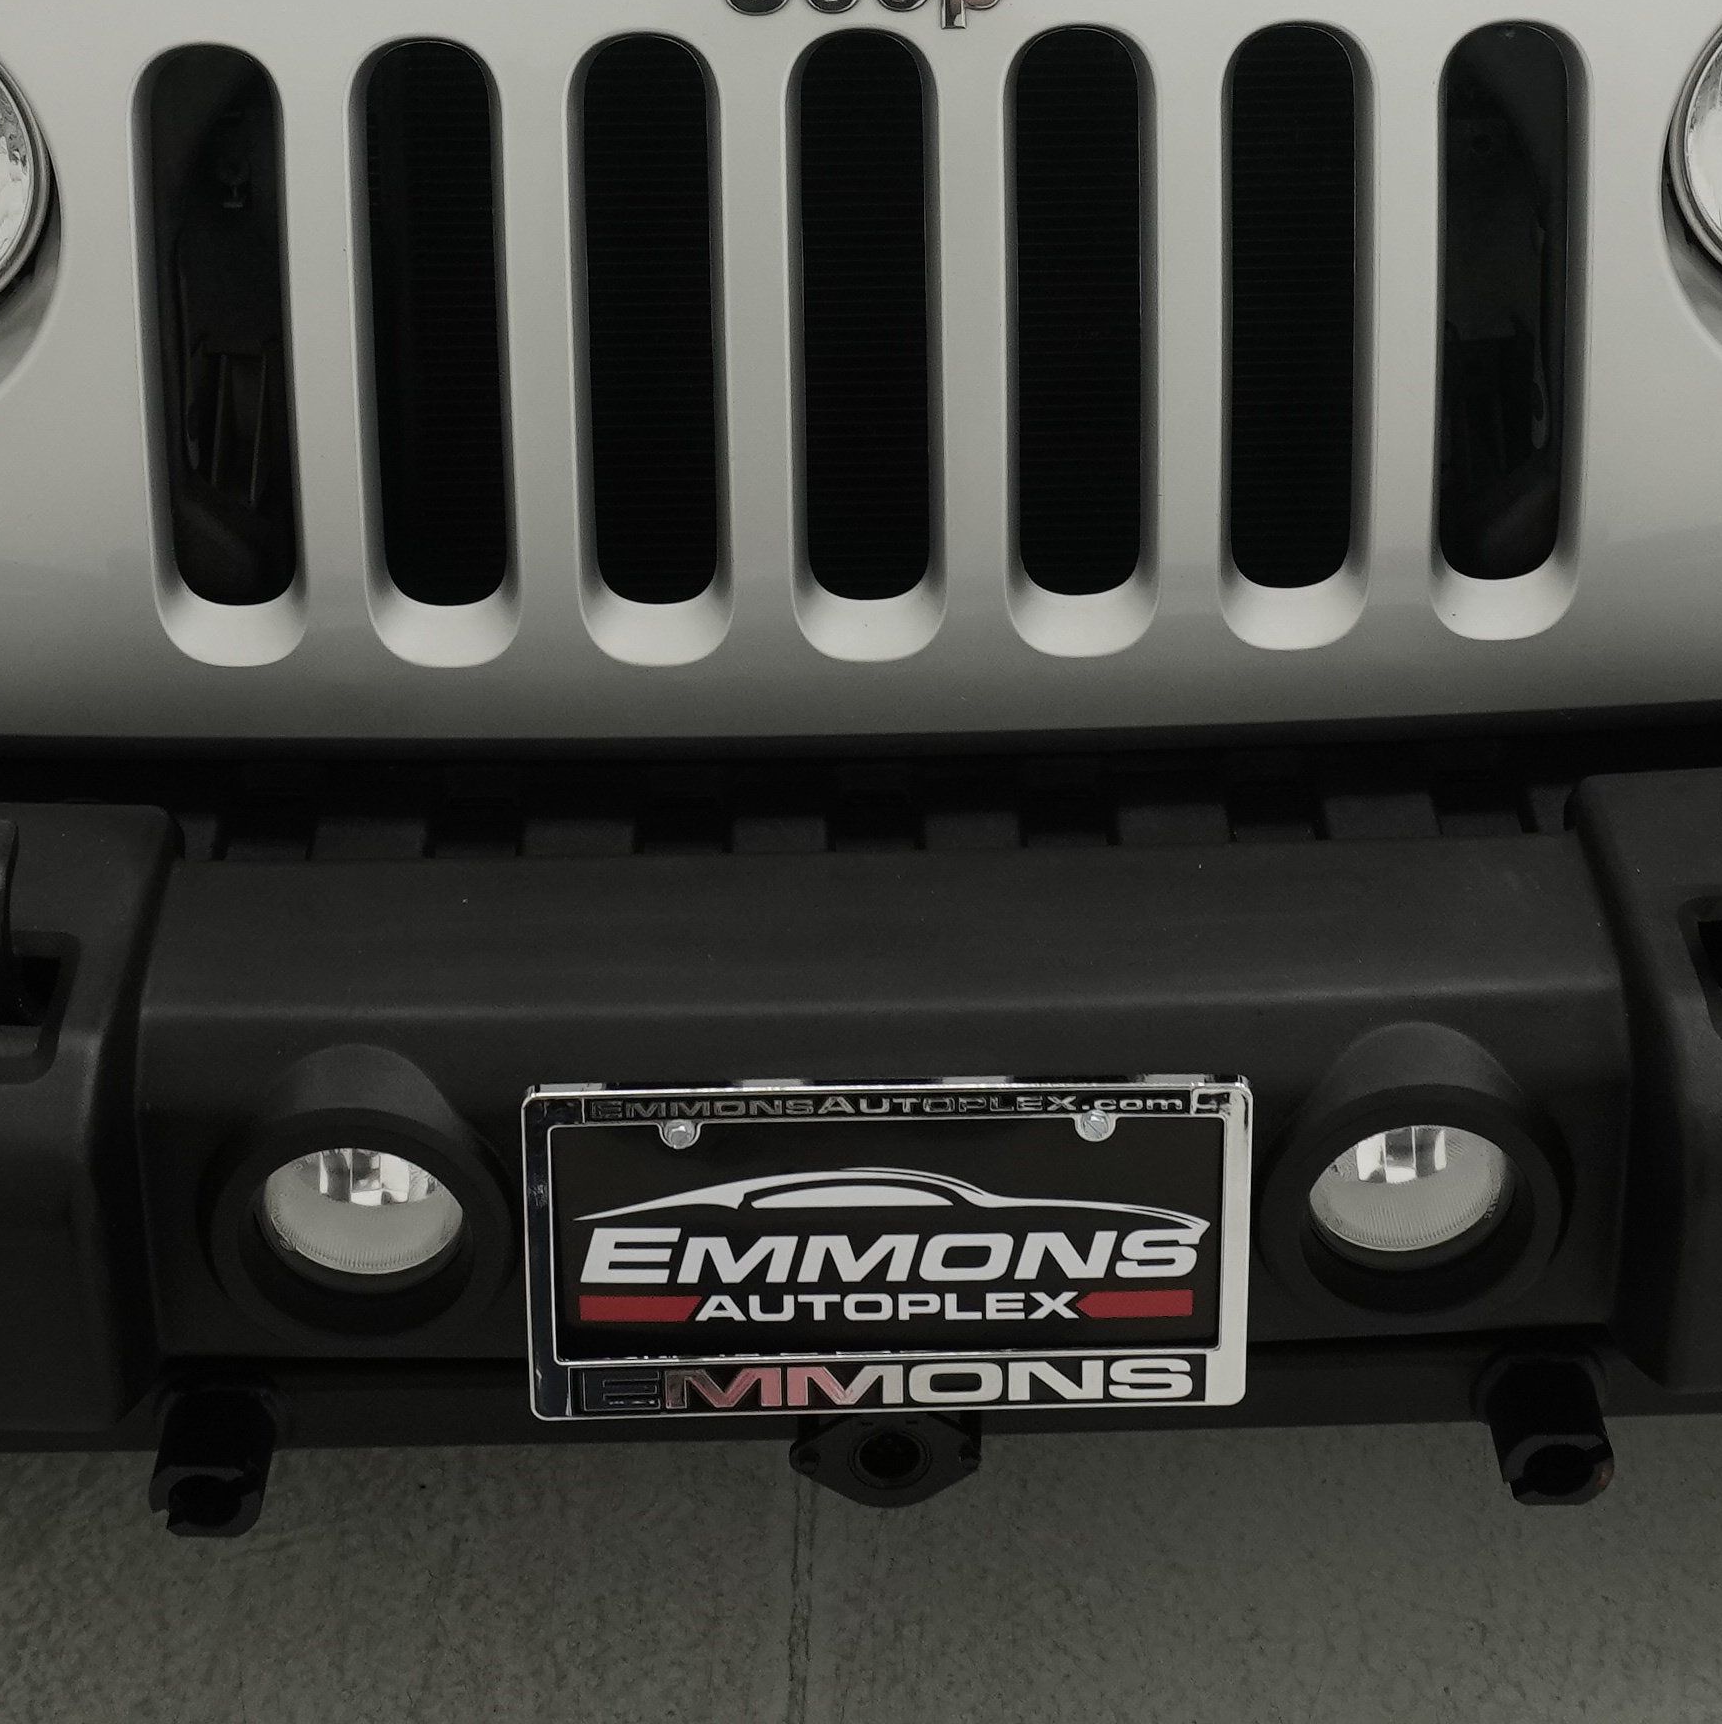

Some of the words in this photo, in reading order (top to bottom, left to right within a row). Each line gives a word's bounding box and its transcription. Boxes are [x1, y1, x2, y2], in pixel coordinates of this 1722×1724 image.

[579, 1226, 1206, 1284] EMMONS
[695, 1291, 1080, 1322] AUTOPLEX
[582, 1358, 1193, 1412] EMMONS
